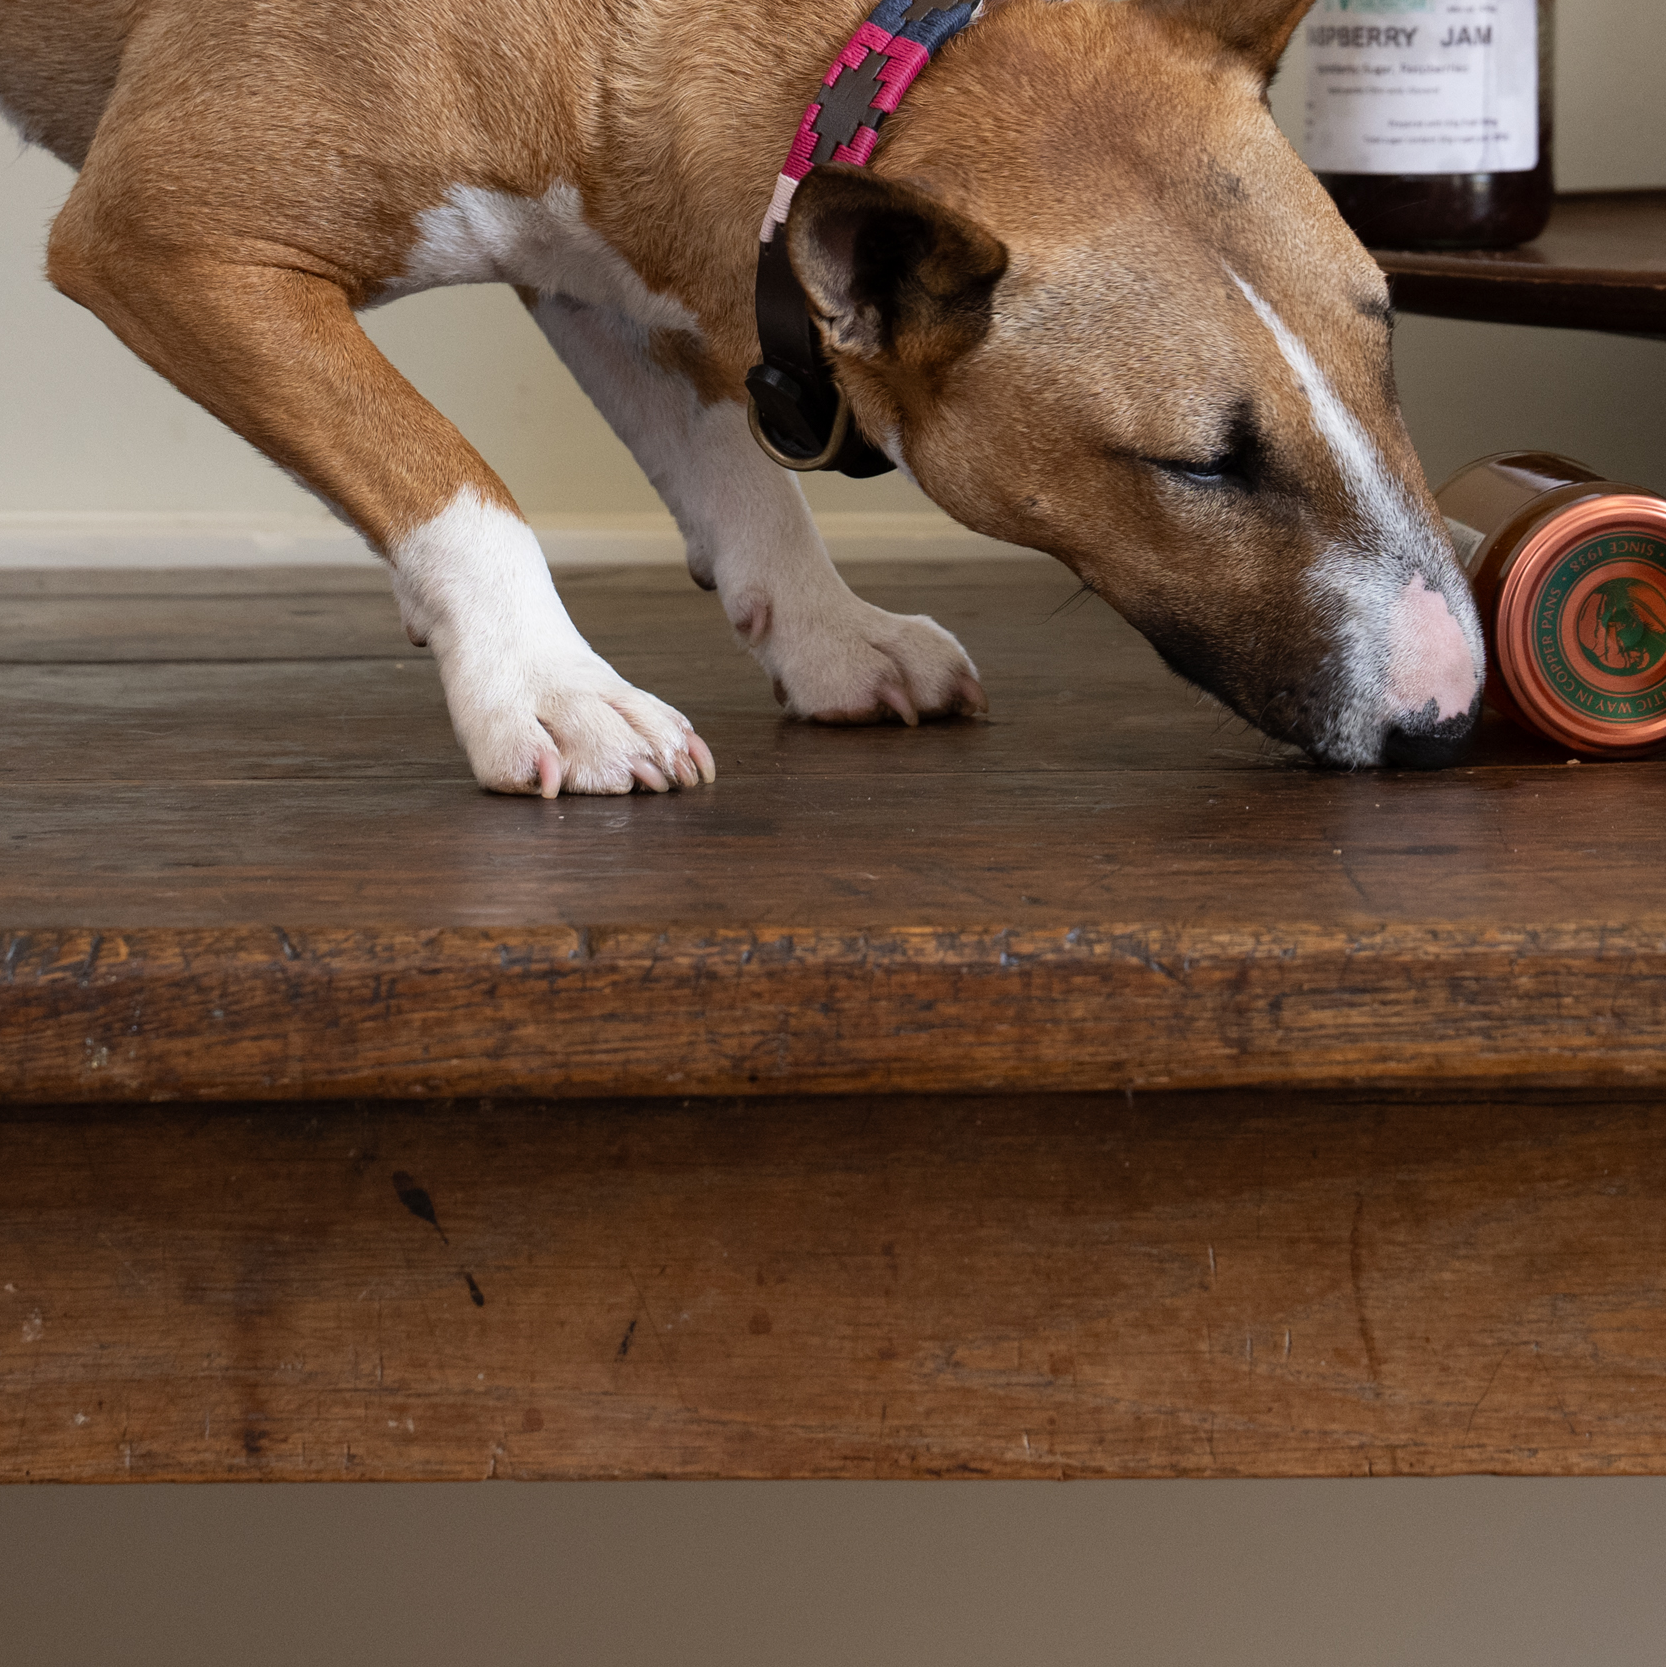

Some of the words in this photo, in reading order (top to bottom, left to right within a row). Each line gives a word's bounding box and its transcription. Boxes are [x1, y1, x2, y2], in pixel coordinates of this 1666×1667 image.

[1440, 26, 1493, 47] JAM
[1608, 540, 1656, 557] SINCE
[1569, 546, 1604, 573] 1938
[1541, 586, 1562, 629] PANS
[1541, 635, 1576, 692] COPPER
[1575, 689, 1593, 706] IN
[1595, 700, 1633, 714] WAY
